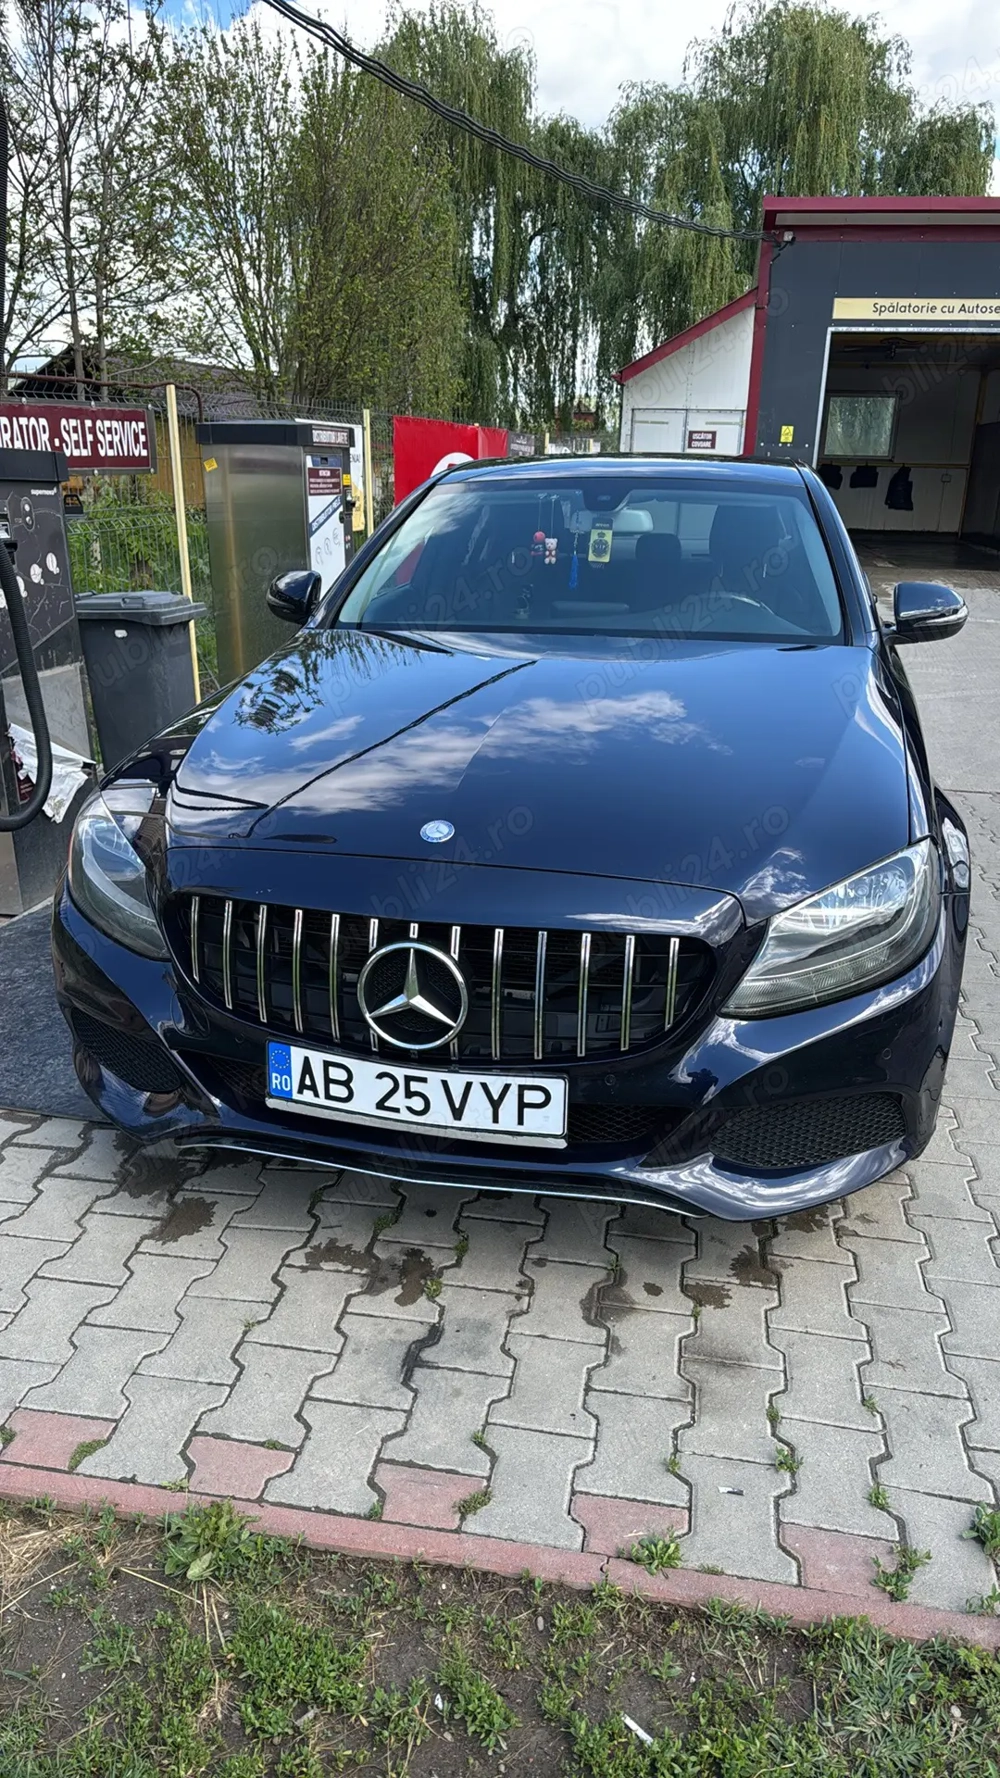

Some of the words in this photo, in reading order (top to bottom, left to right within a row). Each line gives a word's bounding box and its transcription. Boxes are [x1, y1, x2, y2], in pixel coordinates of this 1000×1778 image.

[872, 302, 937, 316] Spălatorie
[940, 304, 955, 314] cu
[958, 303, 1000, 314] Autose
[60, 417, 94, 457] SELF
[95, 419, 148, 457] SERVICE
[272, 1072, 291, 1092] RO
[296, 1055, 355, 1104] AB
[375, 1071, 431, 1116] 25
[441, 1079, 552, 1126] VYP
